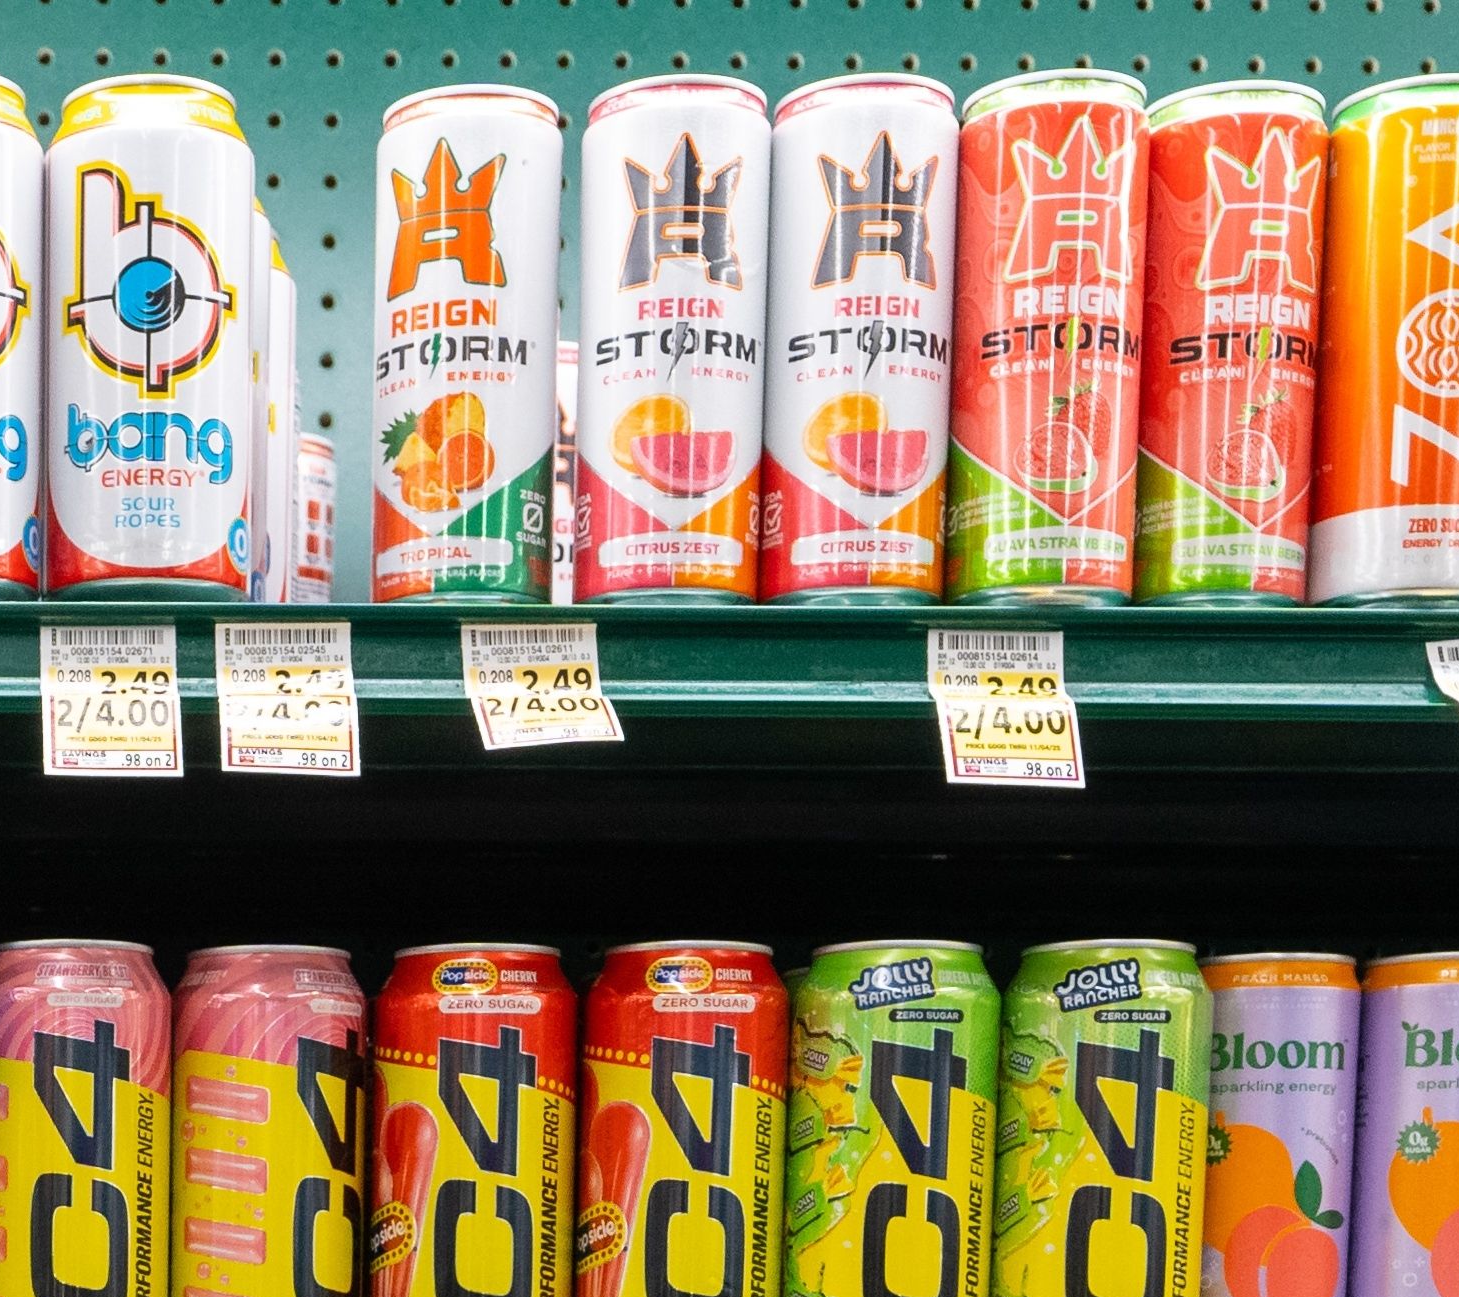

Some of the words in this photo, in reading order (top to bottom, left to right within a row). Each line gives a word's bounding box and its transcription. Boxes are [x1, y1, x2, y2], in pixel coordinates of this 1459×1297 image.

[390, 303, 498, 338] REIGN
[376, 335, 530, 375] STORM
[399, 545, 472, 562] TROPICAL
[954, 705, 1065, 735] 2/4.00
[500, 969, 537, 983] CHERRY
[858, 958, 931, 991] JOLLY
[853, 983, 936, 1004] RANCHER
